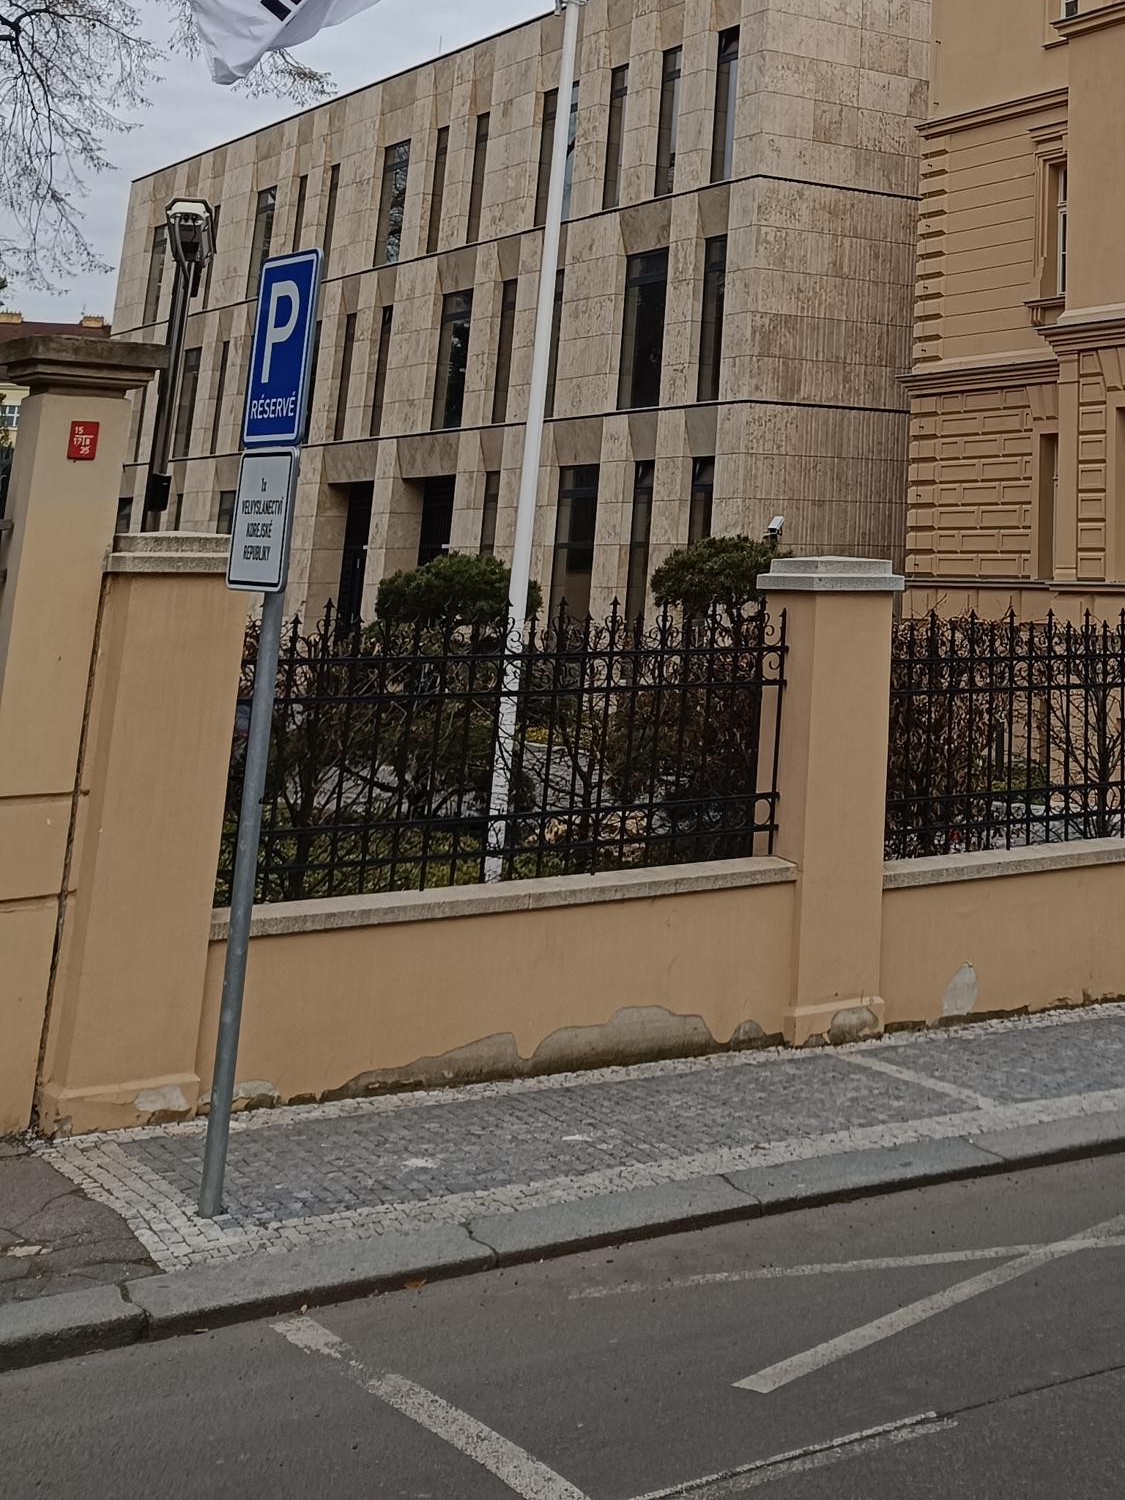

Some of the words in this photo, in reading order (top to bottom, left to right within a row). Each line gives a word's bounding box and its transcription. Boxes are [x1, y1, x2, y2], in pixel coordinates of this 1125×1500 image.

[261, 280, 300, 384] P
[250, 391, 296, 420] RÉSERVÉ
[75, 426, 84, 434] 15
[242, 497, 284, 514] VELVYSLANECTVÍ
[246, 520, 273, 538] KOREJSKÉ
[243, 545, 271, 561] REPUBLIKY
